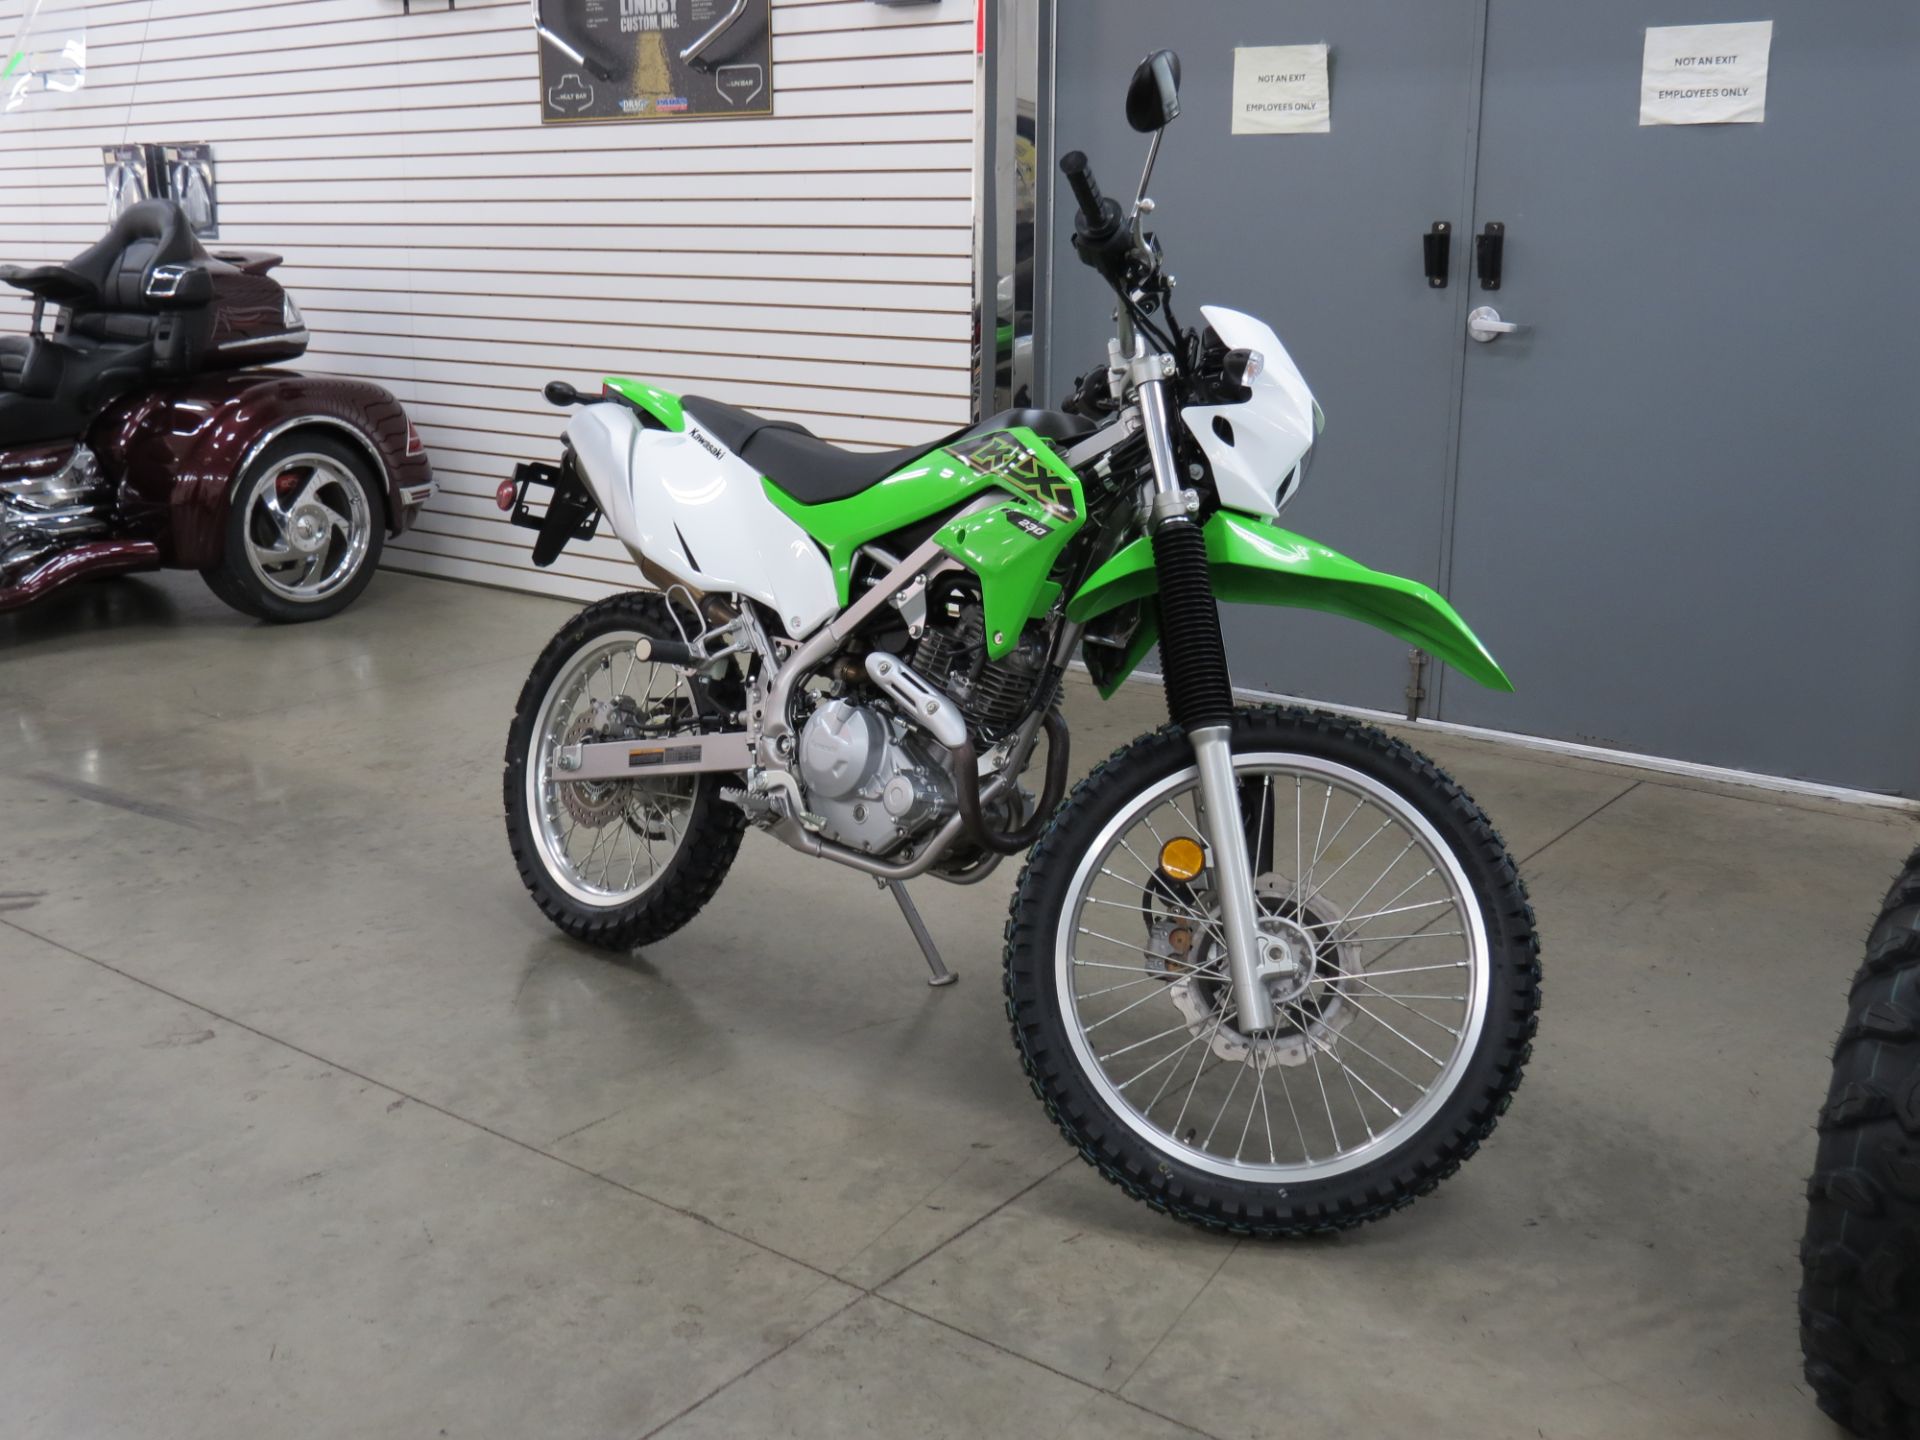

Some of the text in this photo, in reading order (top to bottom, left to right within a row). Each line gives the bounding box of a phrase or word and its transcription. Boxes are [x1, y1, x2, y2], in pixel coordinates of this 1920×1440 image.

[661, 13, 680, 29] INC.
[1674, 55, 1738, 67] NOT AN EXIT
[1258, 74, 1306, 83] NOT AN EXIT
[1659, 87, 1749, 99] EMPLOYEES ONLY
[1246, 103, 1316, 112] EMPLOYEES ONLY
[688, 427, 727, 461] Kawasaki
[1017, 518, 1047, 536] 230
